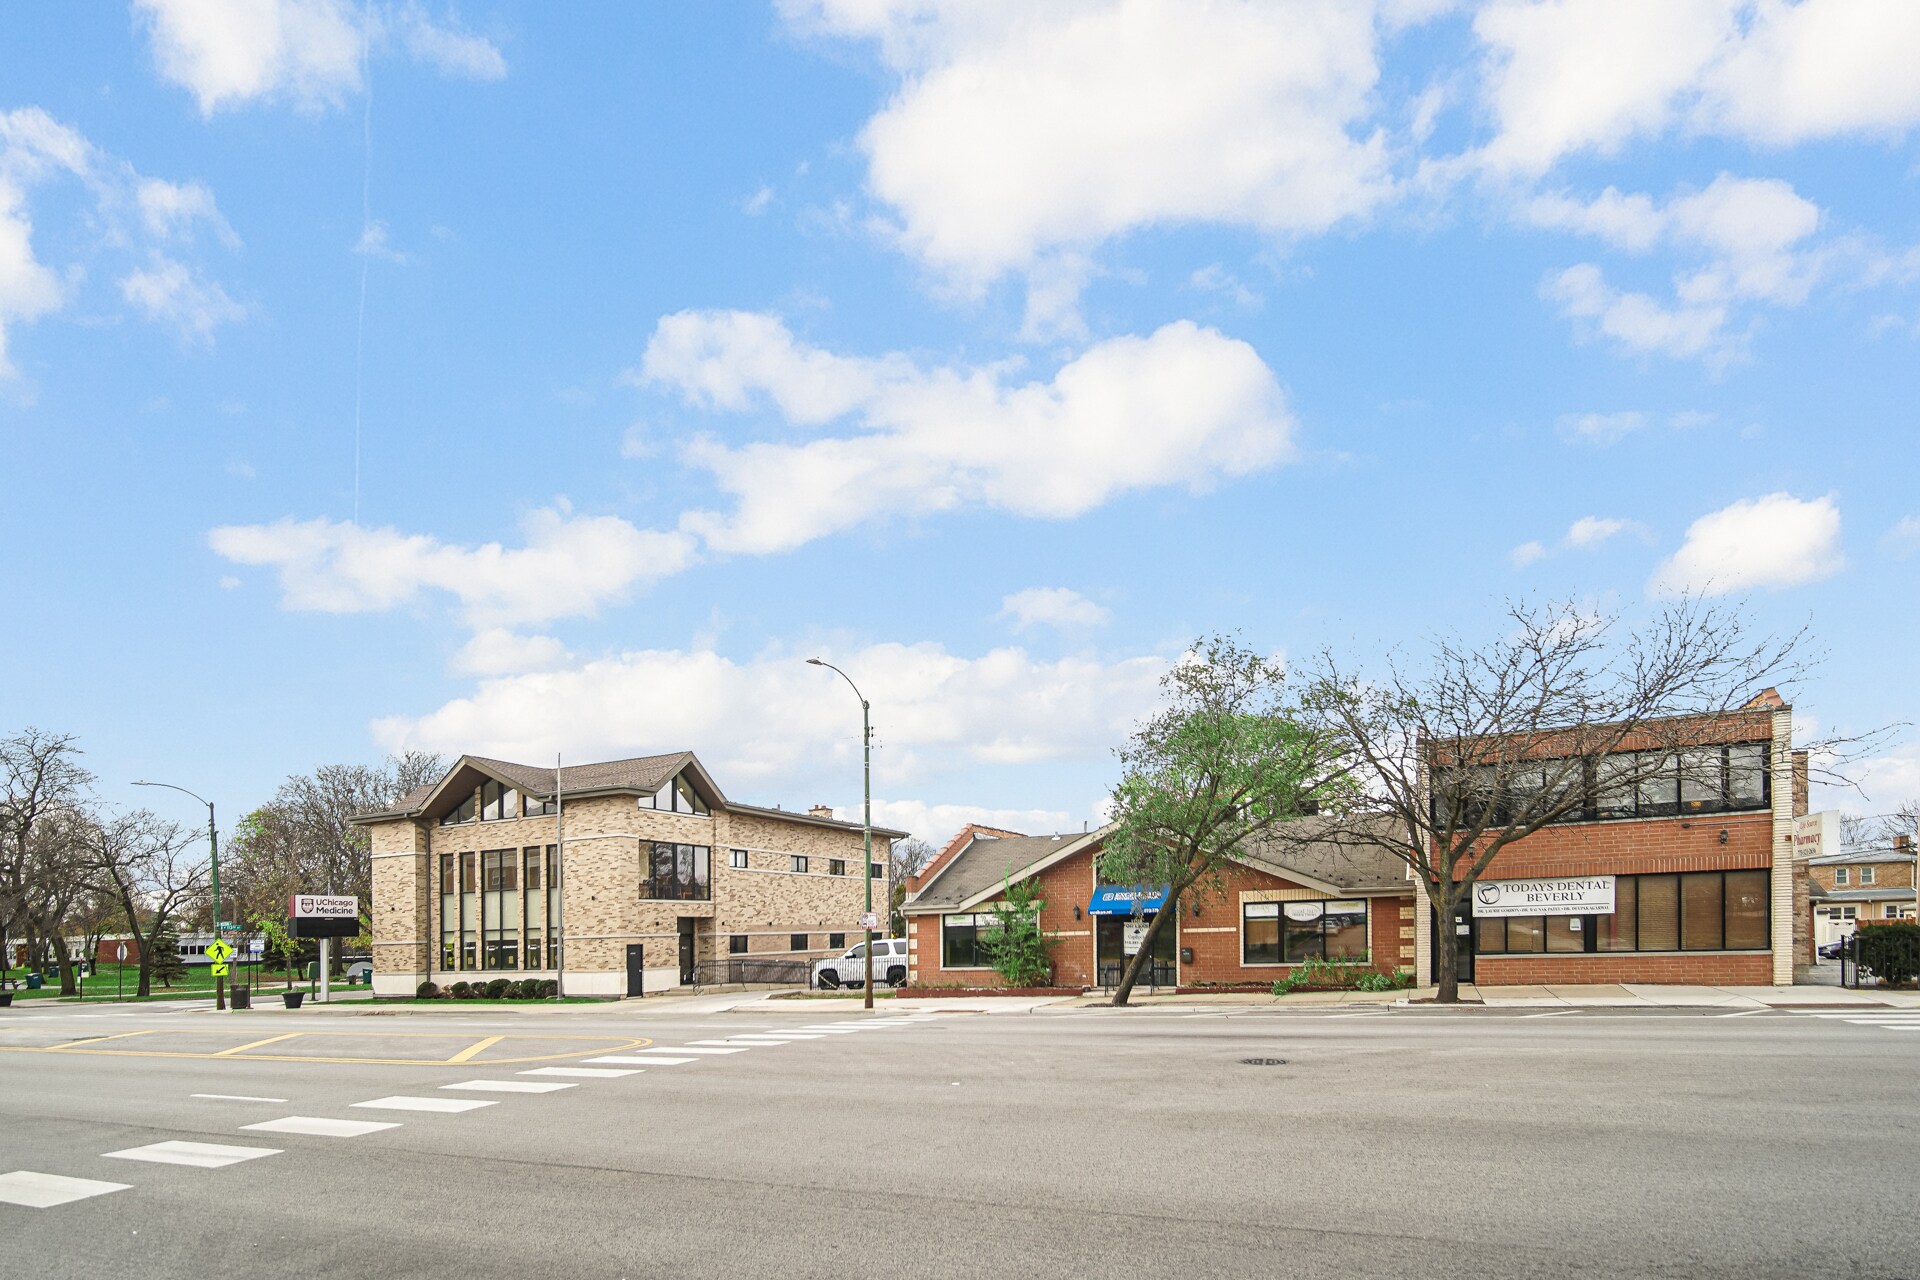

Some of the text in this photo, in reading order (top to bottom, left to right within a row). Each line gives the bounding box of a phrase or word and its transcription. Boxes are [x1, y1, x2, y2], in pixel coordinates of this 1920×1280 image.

[1793, 833, 1821, 846] Pharmacy
[1503, 880, 1610, 893] TODAYS DENTAL
[1527, 892, 1586, 902] BEVERLY
[316, 899, 353, 907] UChicago
